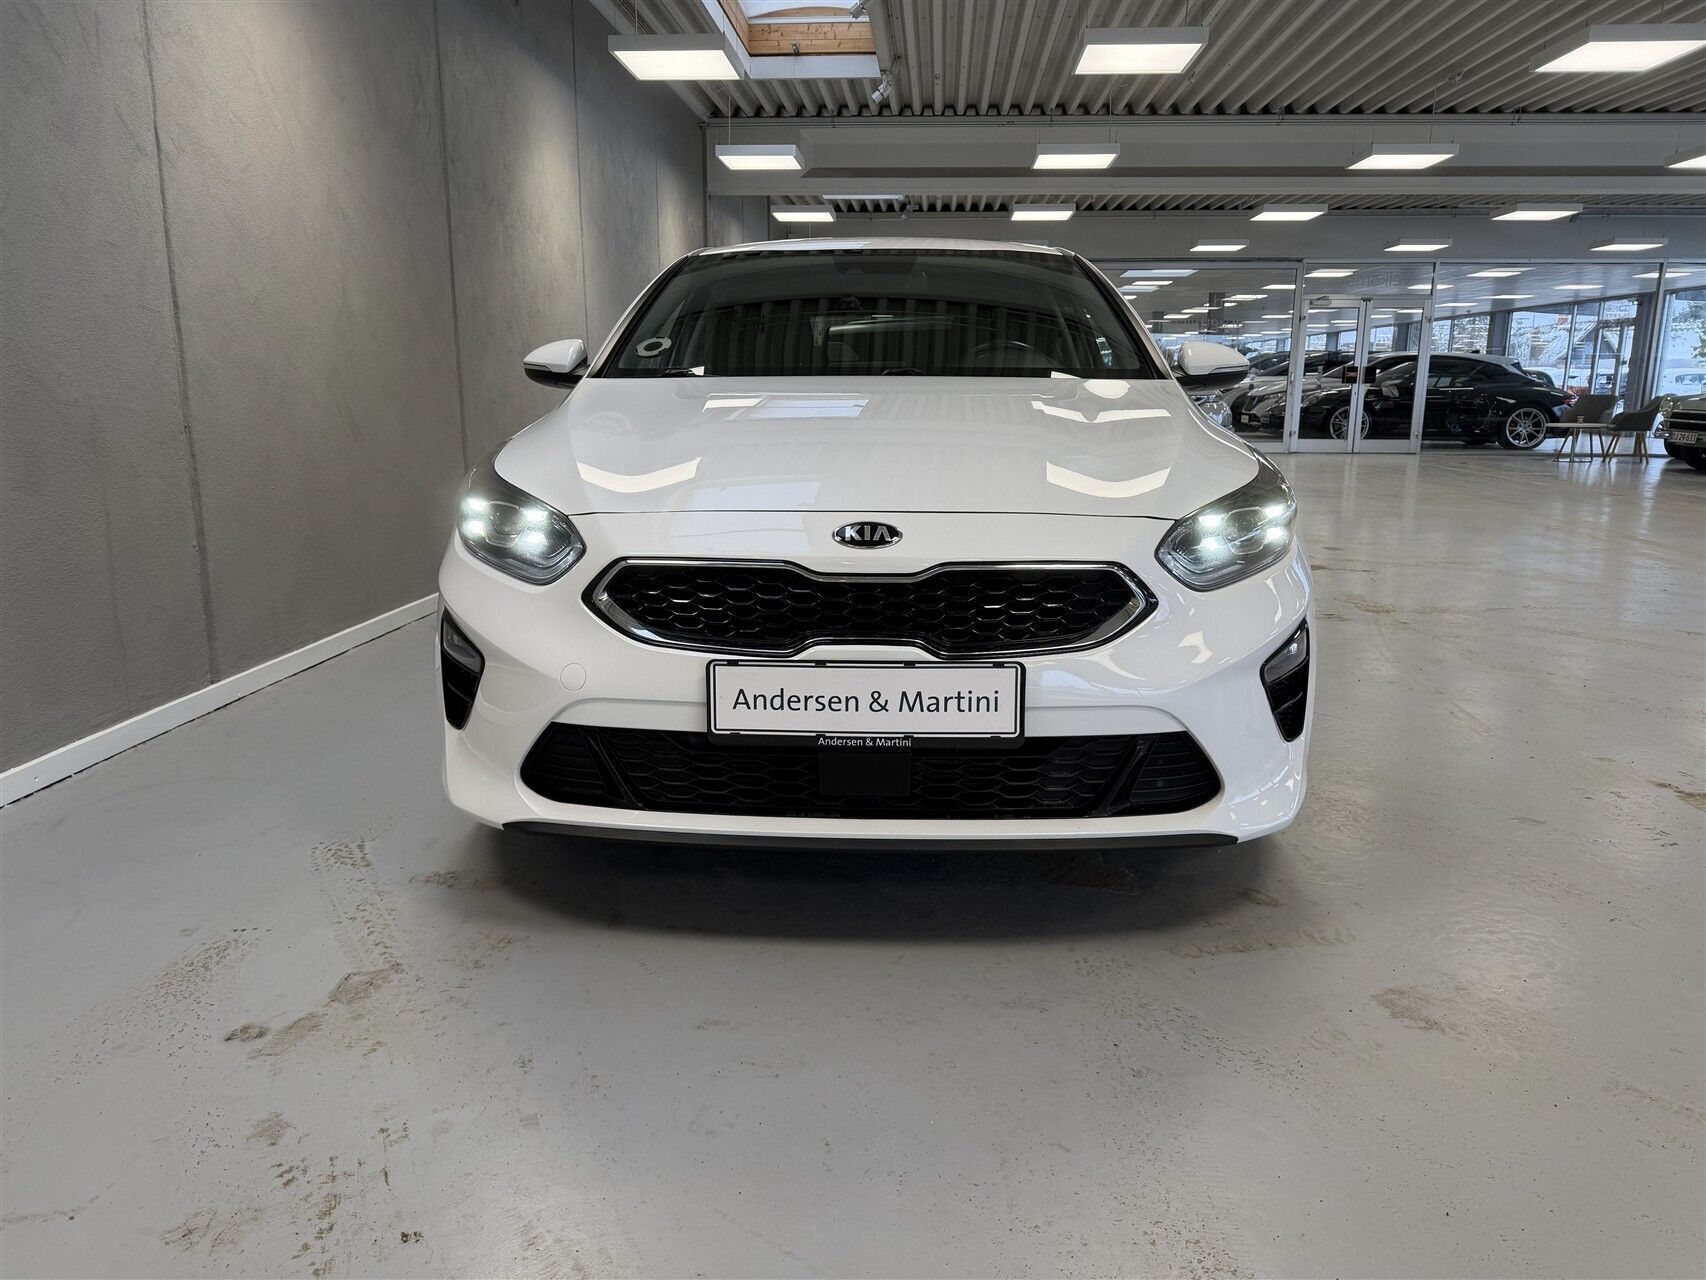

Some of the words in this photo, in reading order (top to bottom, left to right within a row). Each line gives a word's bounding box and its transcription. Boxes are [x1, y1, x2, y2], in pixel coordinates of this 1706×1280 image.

[844, 525, 892, 541] KIA
[733, 688, 860, 712] Andersen
[869, 690, 889, 713] &
[898, 690, 999, 713] Martini
[818, 737, 863, 746] Andersen
[865, 738, 873, 747] &
[876, 738, 912, 747] Martini
